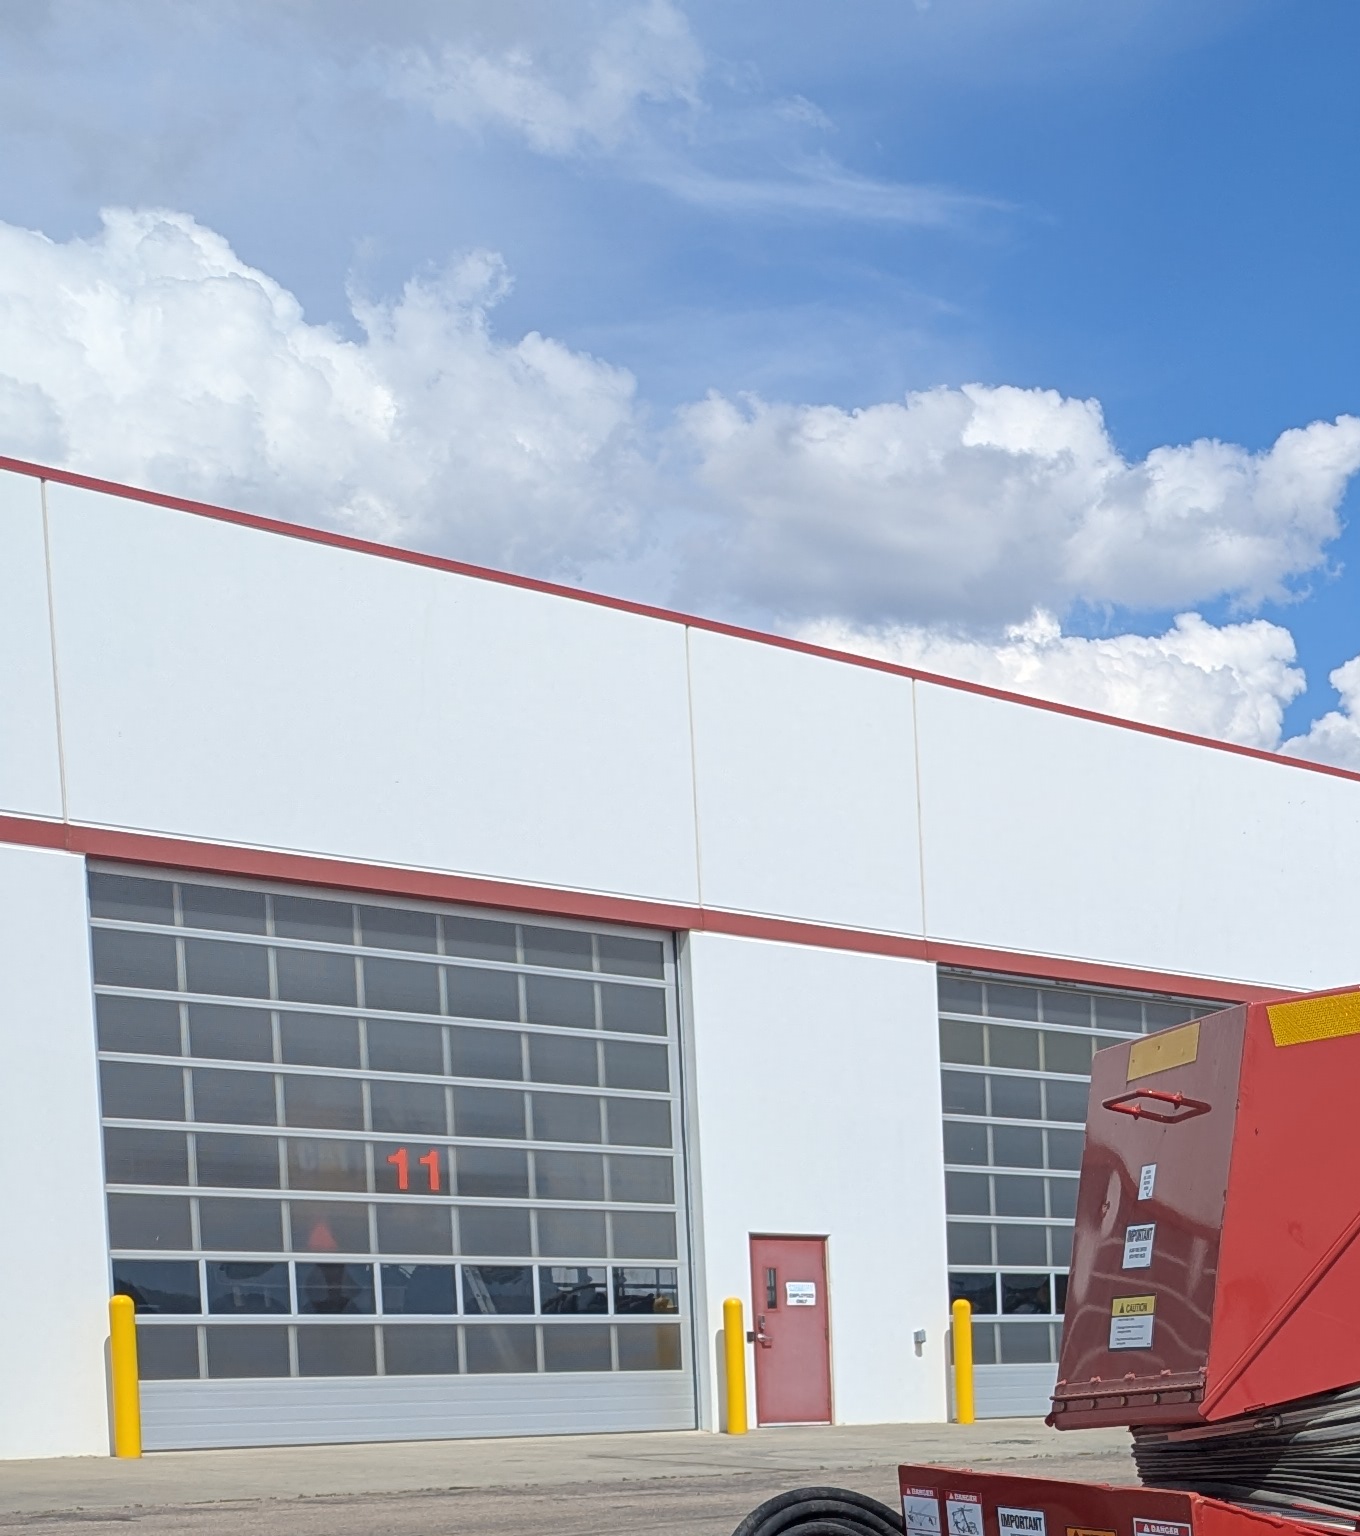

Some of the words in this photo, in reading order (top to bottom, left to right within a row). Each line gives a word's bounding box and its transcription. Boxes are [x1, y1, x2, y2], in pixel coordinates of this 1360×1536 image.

[387, 1147, 440, 1191] 11
[1125, 1302, 1148, 1314] CAUTION
[1000, 1513, 1043, 1532] IMPORTANT
[1150, 1525, 1180, 1536] DANGER
